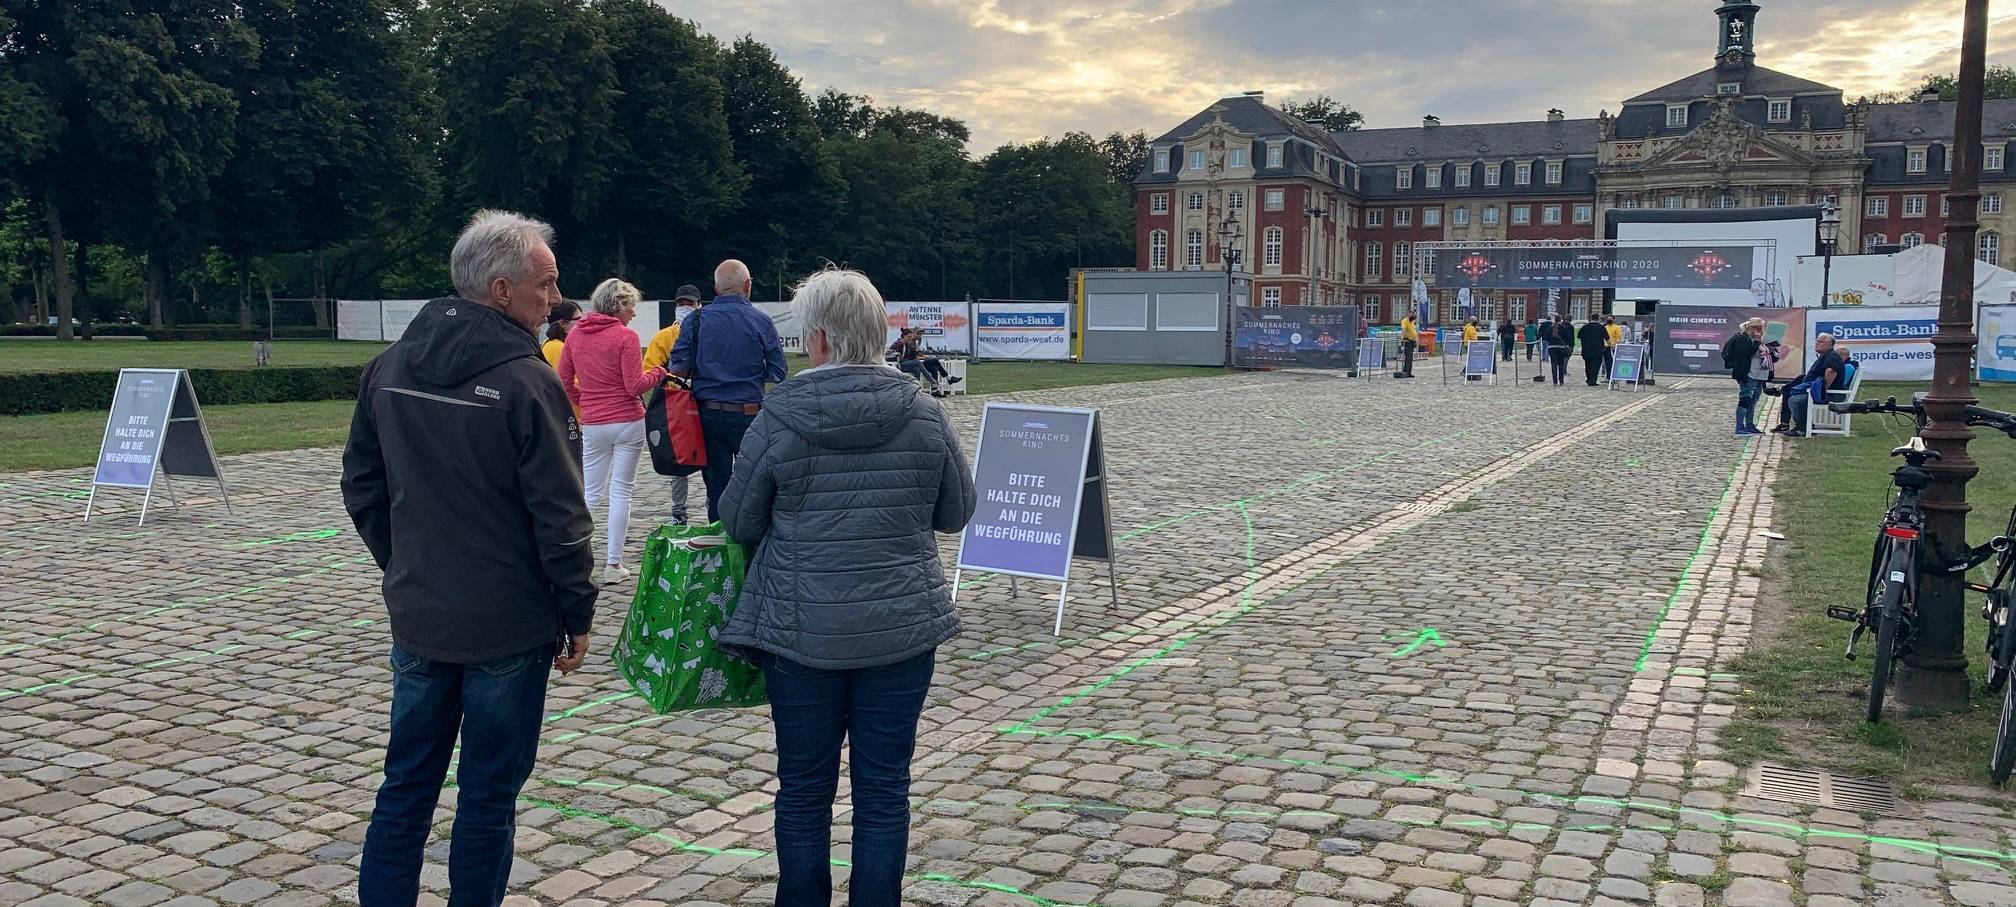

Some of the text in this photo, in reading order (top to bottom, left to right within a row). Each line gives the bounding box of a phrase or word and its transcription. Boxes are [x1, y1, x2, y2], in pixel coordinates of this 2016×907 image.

[1519, 260, 1660, 270] SOMMERNACHTSKINO 2020
[909, 306, 943, 314] ANTENNE
[908, 313, 943, 322] MÜNSTER
[987, 315, 1055, 326] Sparda-Bank
[978, 335, 1064, 344] www.sparda-west.de
[128, 415, 149, 425] BITTE
[115, 428, 155, 438] HALTE DICH
[999, 429, 1071, 443] SOMMERNACHTS
[120, 441, 144, 451] AN DIE
[1022, 440, 1044, 449] KINO
[105, 452, 152, 464] WEGFÜHRUNG
[1009, 473, 1046, 488] BITTE
[986, 489, 1062, 509] HALTE DICH
[998, 509, 1043, 525] AN DIE
[974, 524, 1062, 546] WEGFÜHRUNG
